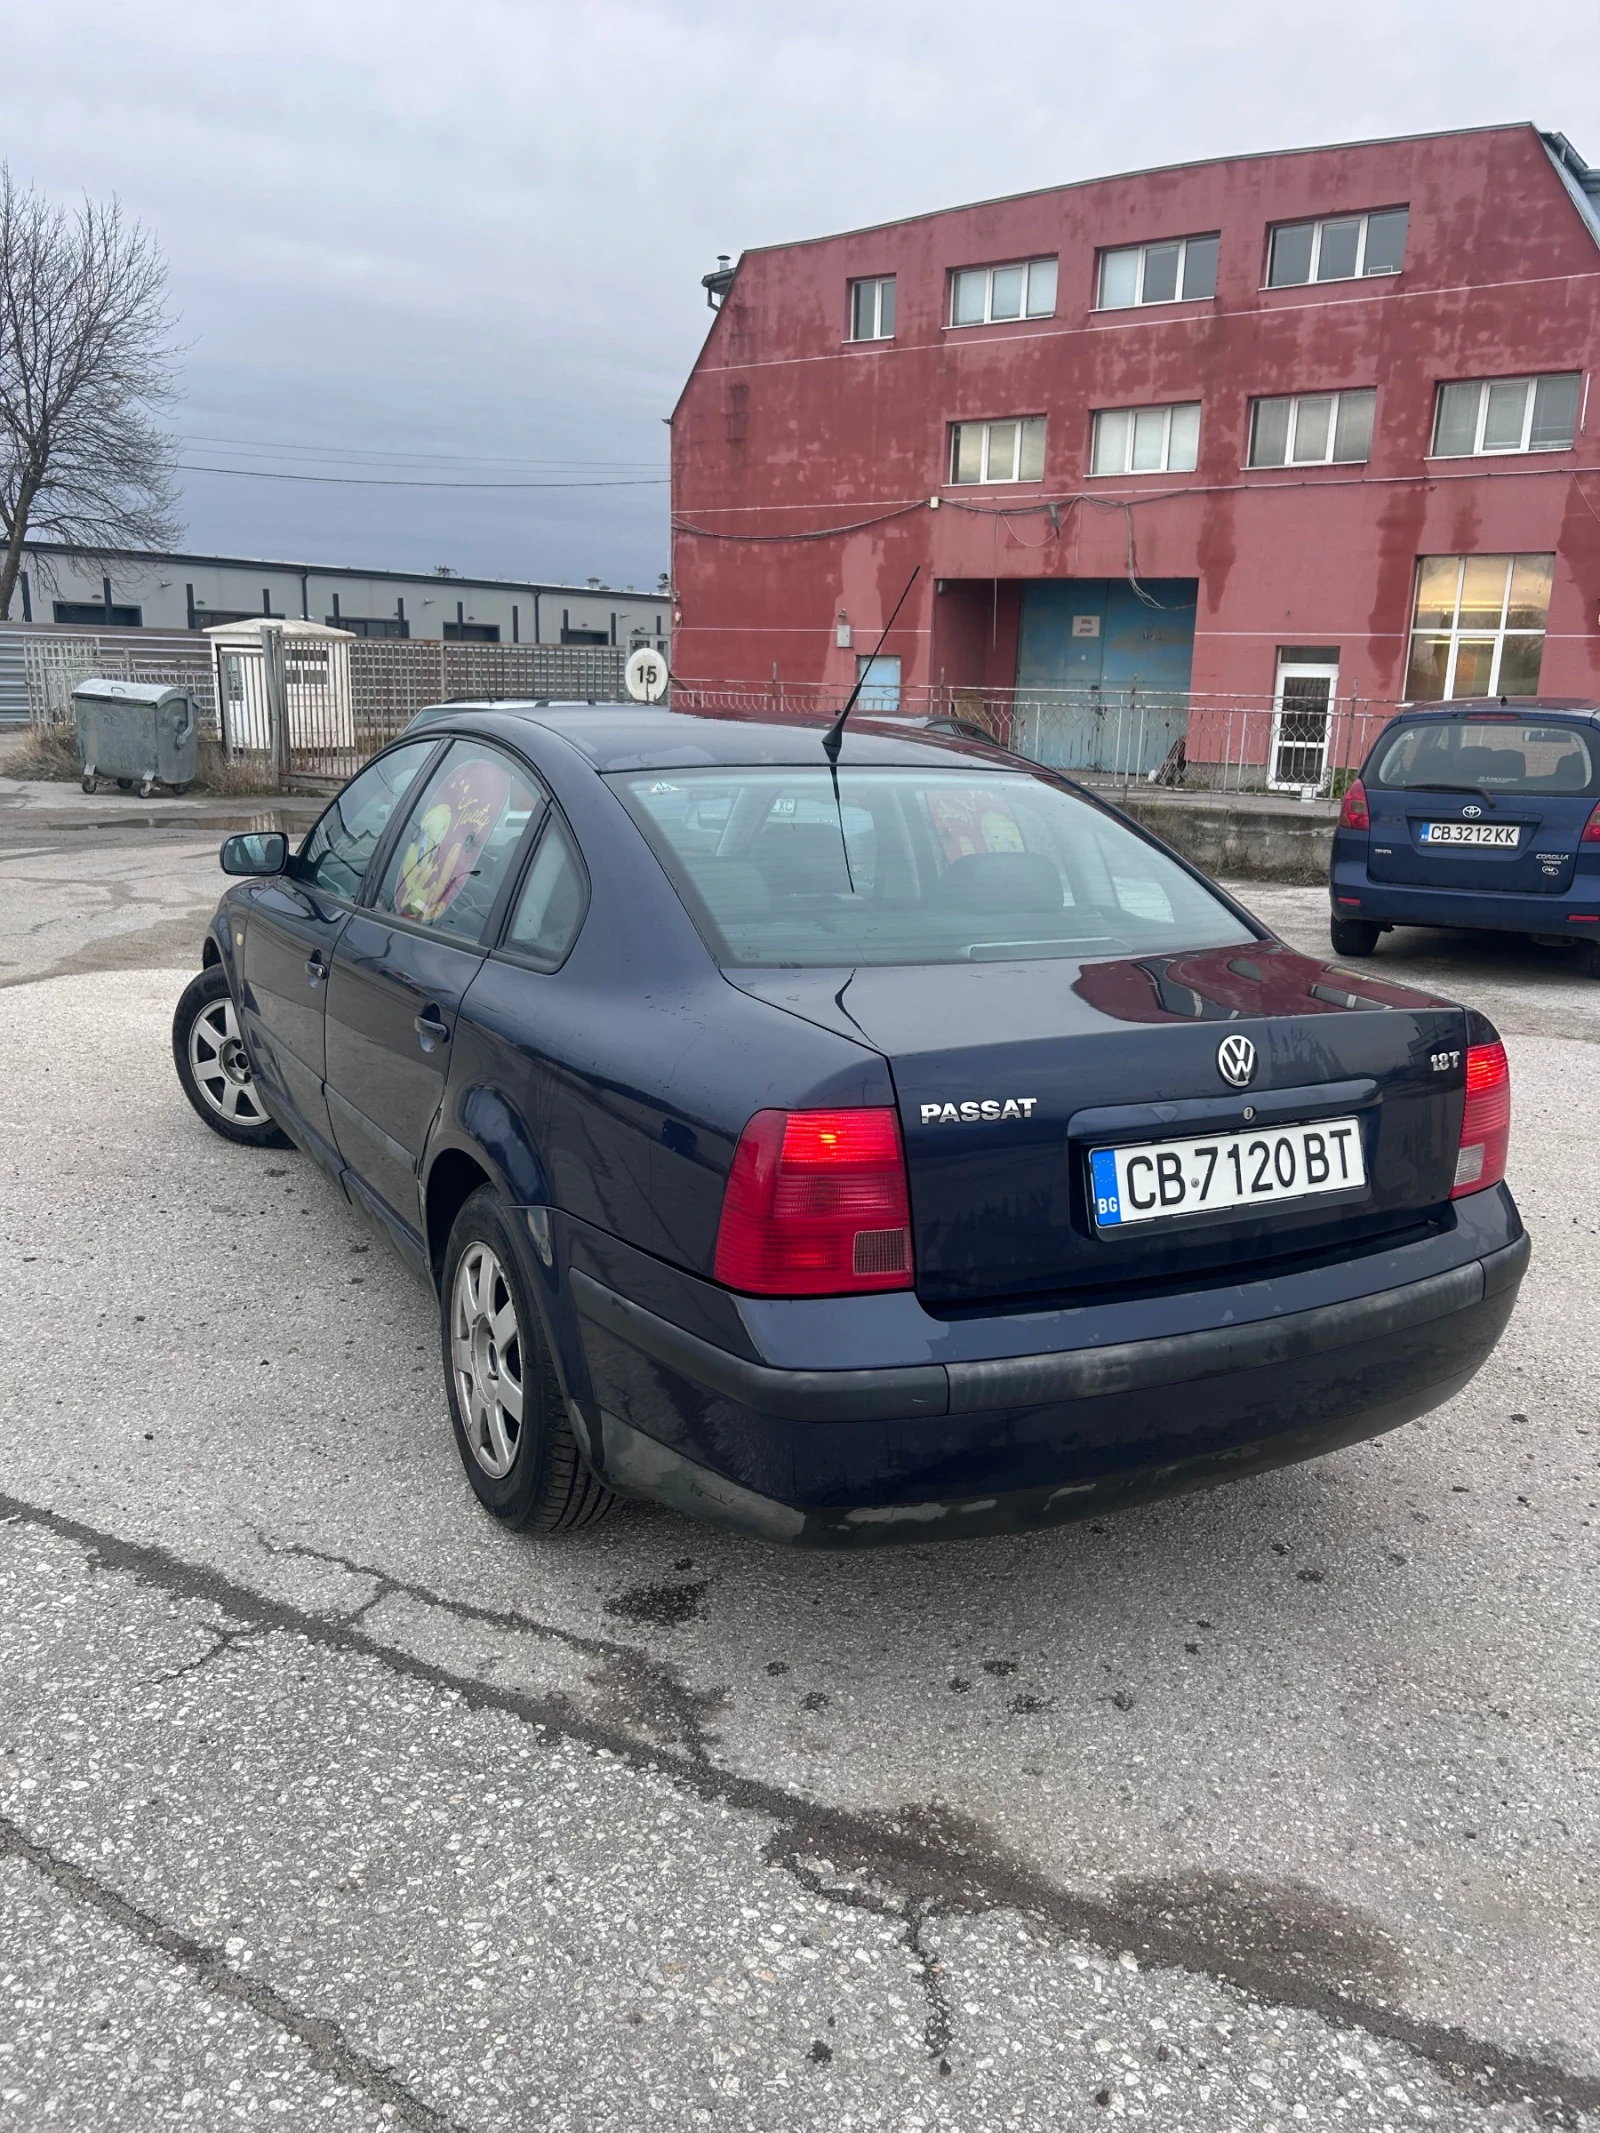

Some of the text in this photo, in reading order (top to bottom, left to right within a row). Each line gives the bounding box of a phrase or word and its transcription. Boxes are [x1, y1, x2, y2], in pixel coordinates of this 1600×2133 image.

[637, 665, 657, 684] 15
[453, 797, 491, 837] Tweety
[920, 1098, 1037, 1124] PASSAT
[1098, 1198, 1118, 1214] BG
